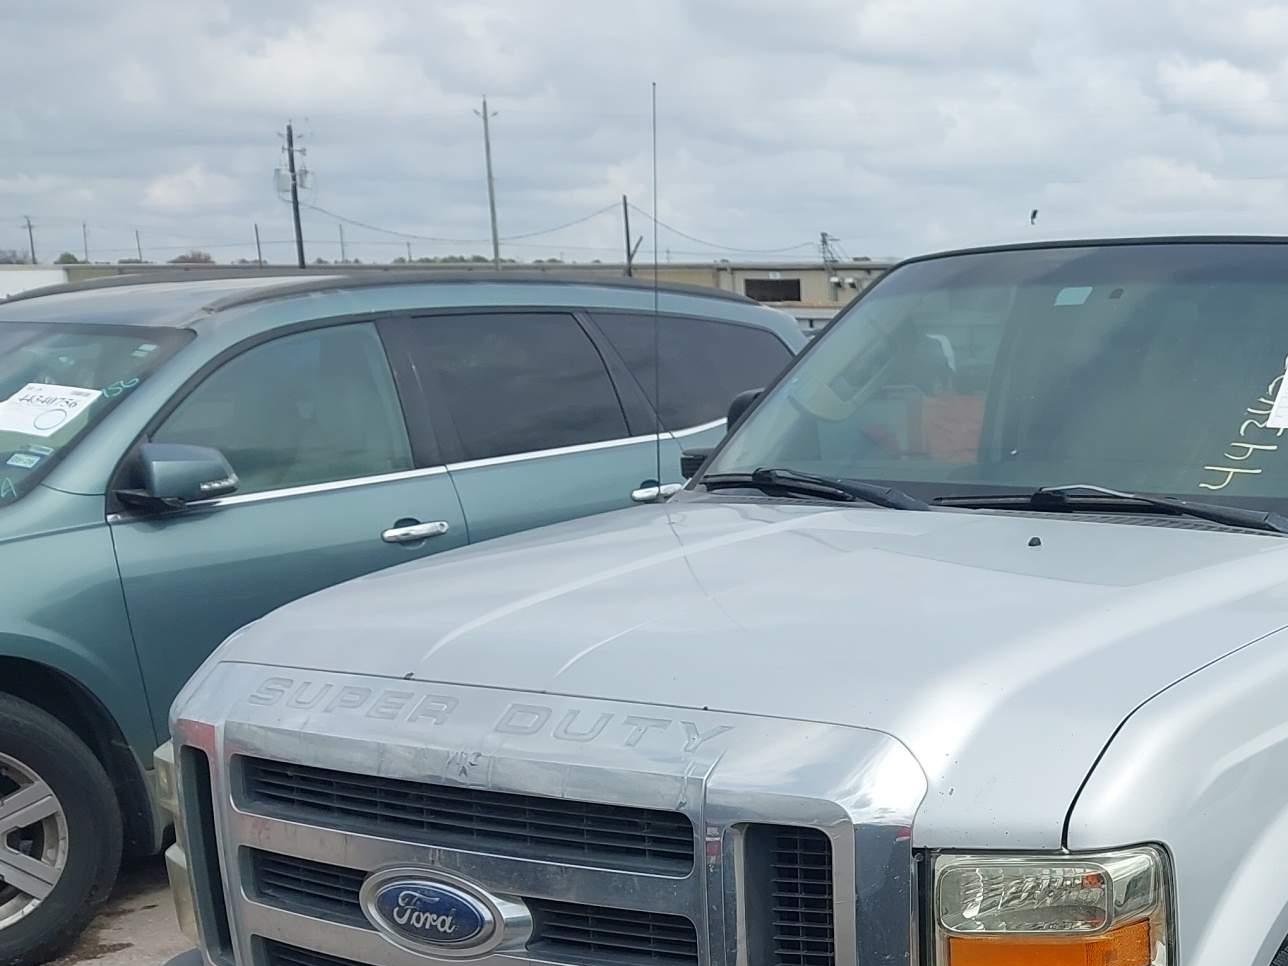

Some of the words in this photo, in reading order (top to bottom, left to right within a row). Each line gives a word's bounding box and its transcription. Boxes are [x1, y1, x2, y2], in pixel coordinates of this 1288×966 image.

[249, 676, 461, 726] SUPER
[495, 702, 737, 753] DUTY
[392, 890, 459, 935] Ford
